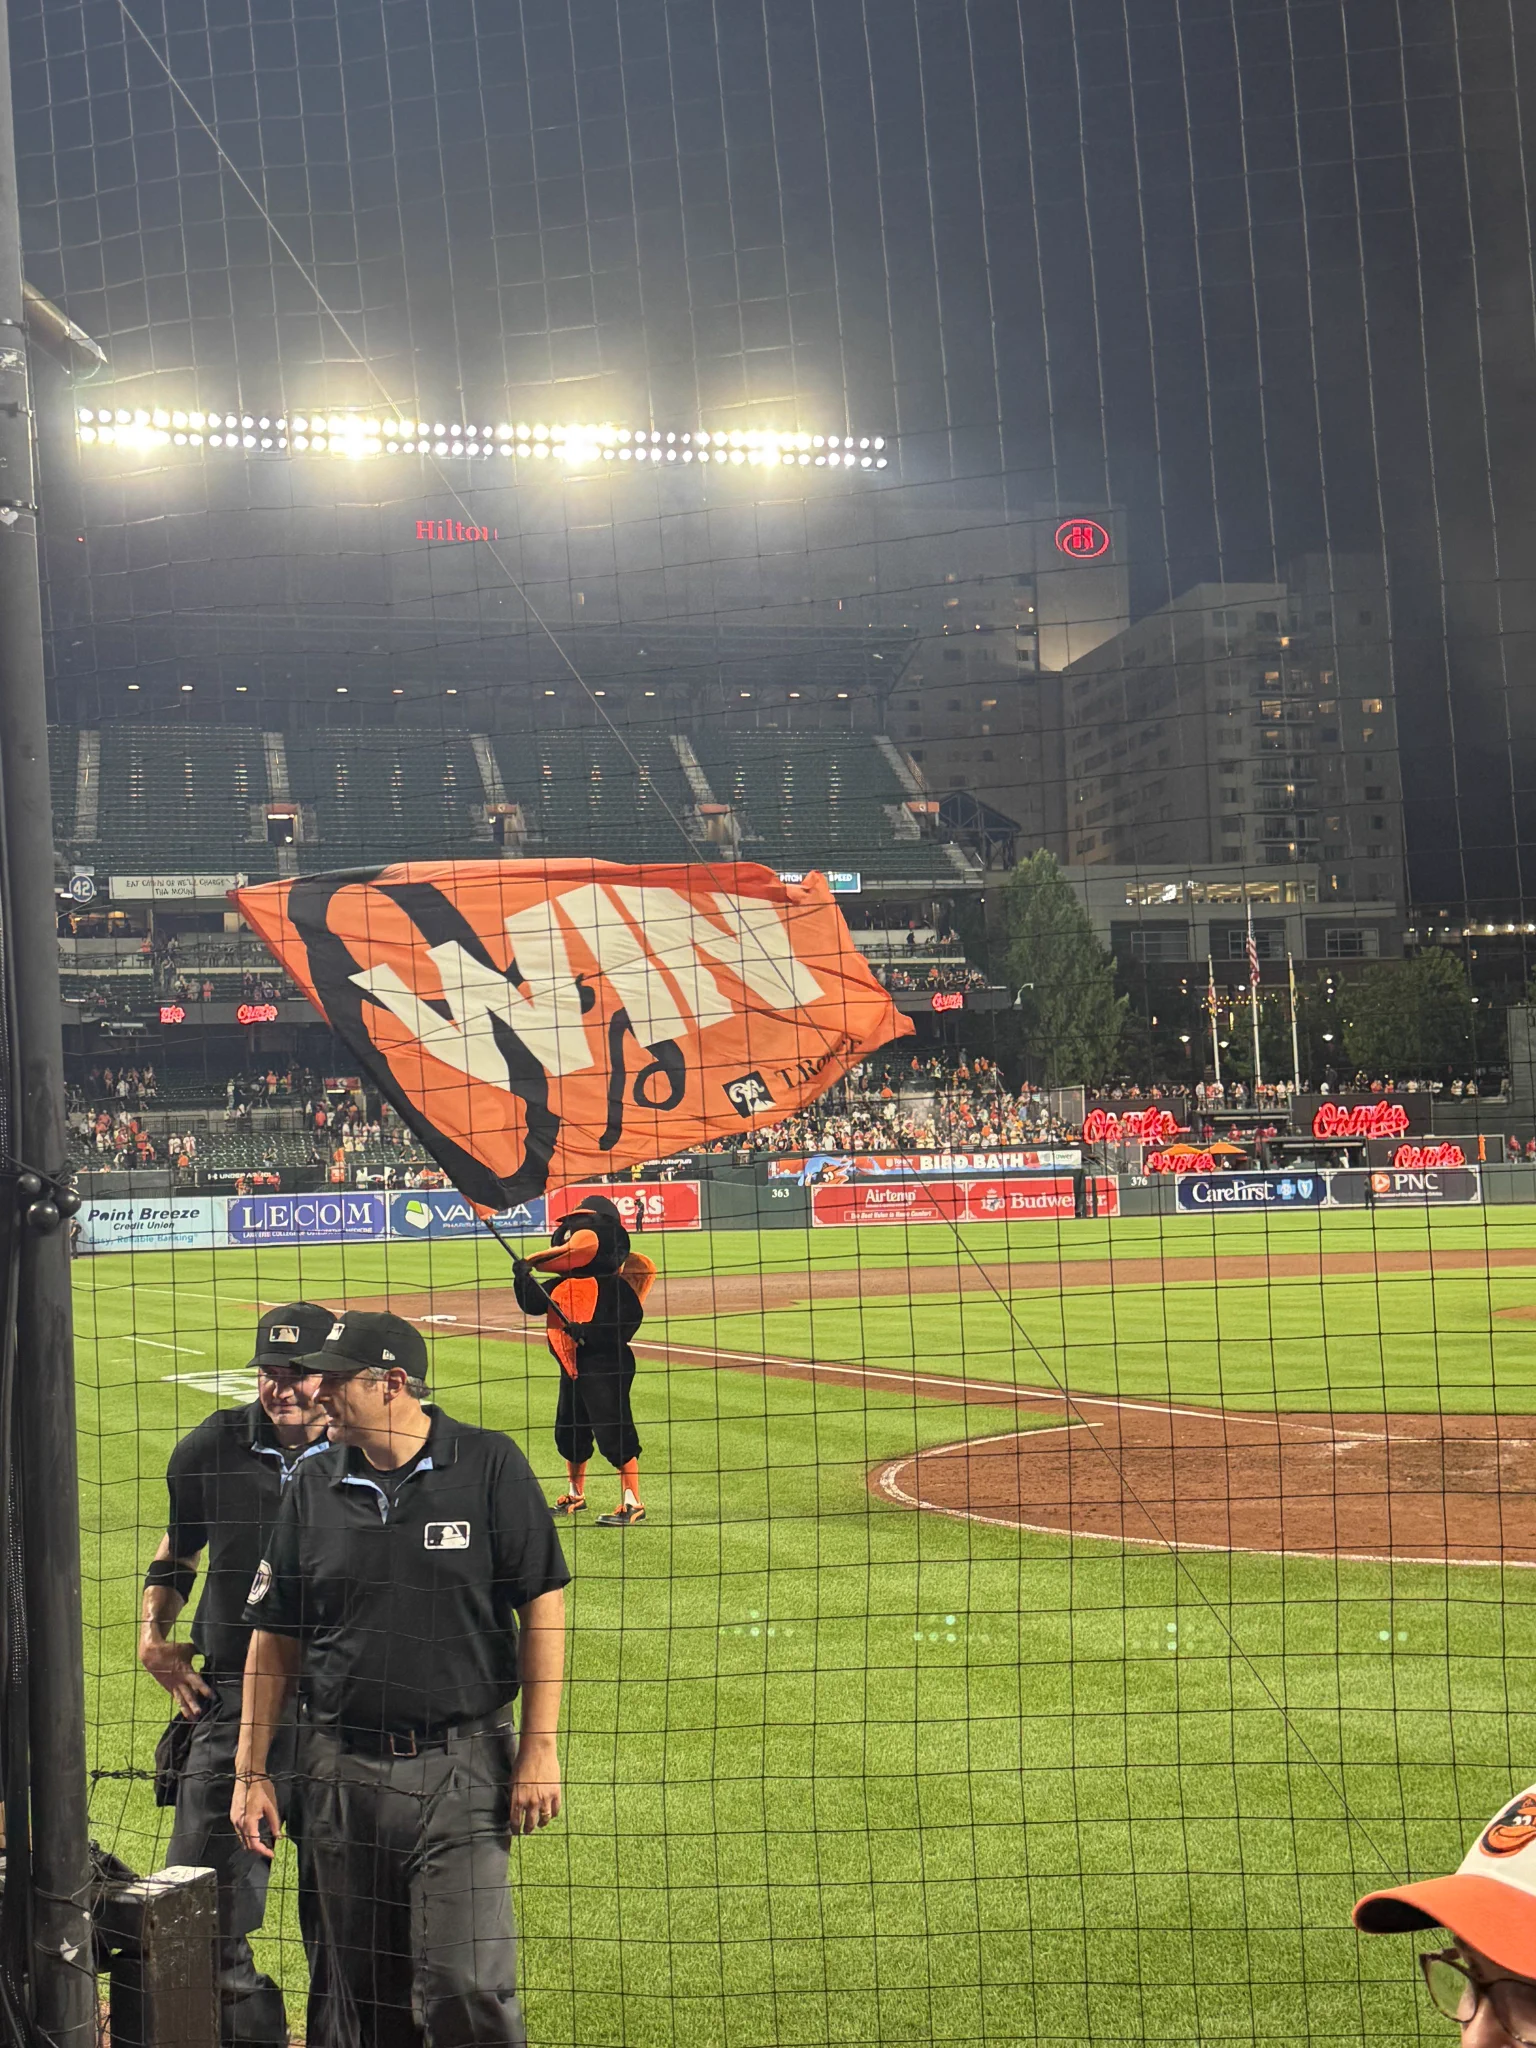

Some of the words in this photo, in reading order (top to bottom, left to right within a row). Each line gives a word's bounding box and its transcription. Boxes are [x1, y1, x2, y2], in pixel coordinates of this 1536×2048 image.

[73, 880, 91, 896] 42
[348, 883, 826, 1091] WIN
[920, 1155, 969, 1170] BIRD
[973, 1153, 1024, 1169] BATH
[1130, 1176, 1148, 1186] 376
[1393, 1173, 1439, 1190] PNC
[771, 1188, 790, 1198] 363
[865, 1188, 916, 1207] Airtemp
[1192, 1180, 1275, 1203] CareFirst
[88, 1208, 133, 1221] Point
[140, 1207, 200, 1220] Breeze
[113, 1222, 144, 1230] Credit
[147, 1221, 175, 1229] Union
